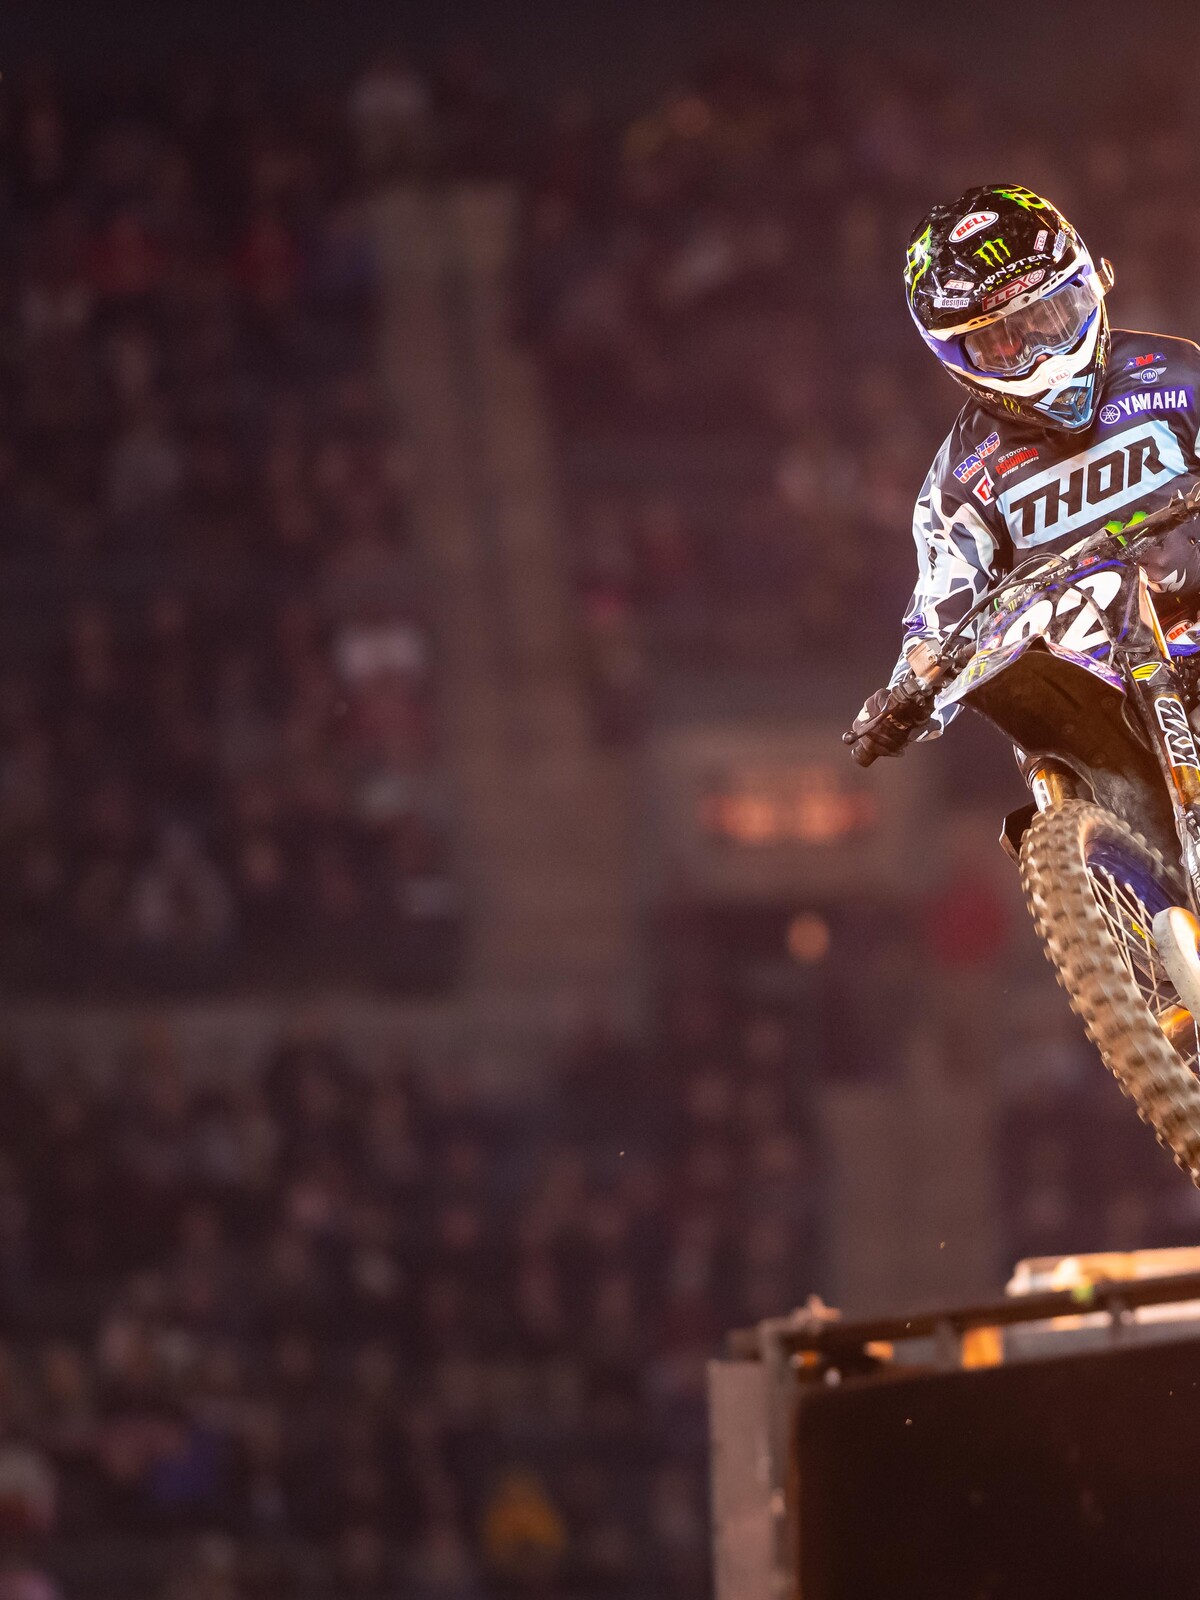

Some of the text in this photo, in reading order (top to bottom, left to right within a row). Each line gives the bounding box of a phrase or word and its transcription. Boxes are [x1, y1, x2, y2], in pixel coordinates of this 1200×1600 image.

[955, 215, 991, 238] BELL
[973, 253, 1051, 296] MONSTER
[987, 261, 1041, 291] ENERGY
[941, 298, 969, 307] designs
[982, 275, 1029, 311] FLEX
[1123, 352, 1167, 370] AMA
[1142, 372, 1156, 380] FIM
[1117, 390, 1188, 416] YAMAHA
[954, 433, 999, 479] PATS
[995, 448, 1039, 475] ESCONDIDO
[1006, 447, 1028, 458] TOYOTA
[1009, 435, 1167, 538] THOR
[1018, 565, 1073, 600] MONTER
